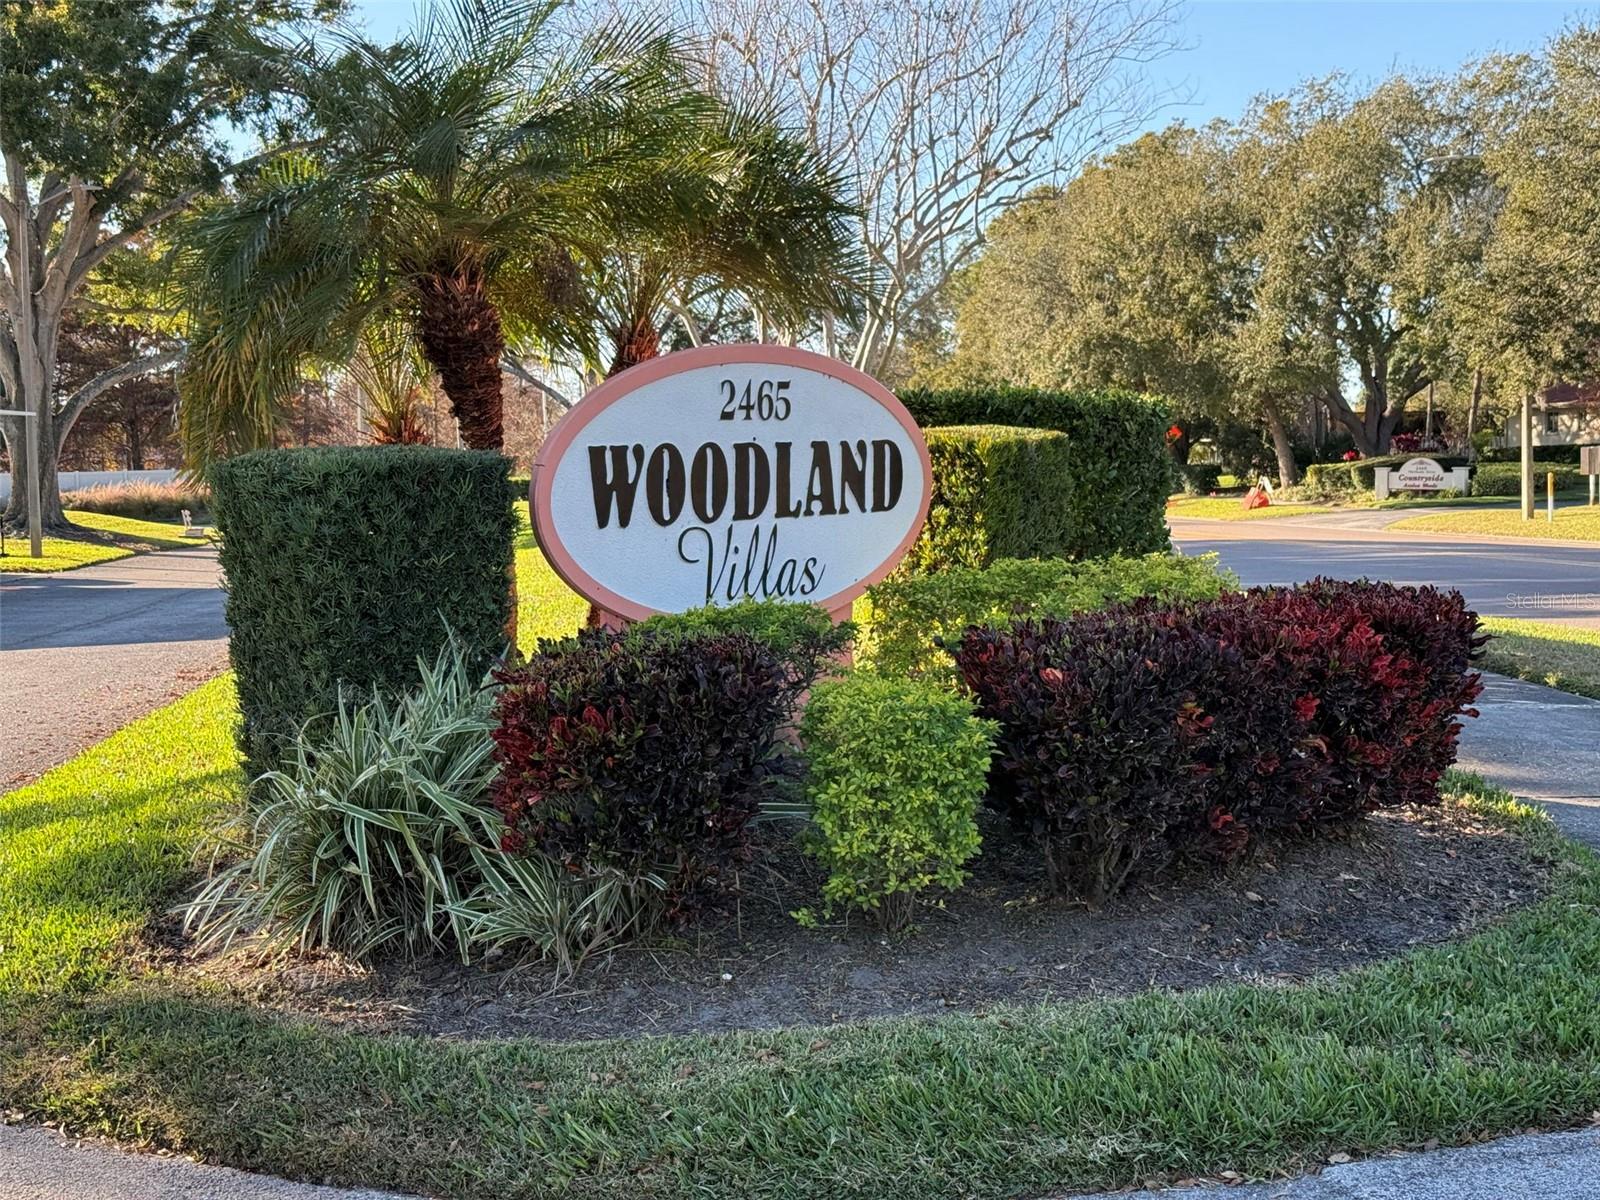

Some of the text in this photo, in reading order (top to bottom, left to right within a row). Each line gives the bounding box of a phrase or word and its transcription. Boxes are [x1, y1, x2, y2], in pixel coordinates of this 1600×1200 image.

[719, 379, 791, 421] 2465
[588, 439, 903, 529] WOODLAND
[1398, 474, 1444, 482] Countryside
[678, 524, 827, 605] Villas
